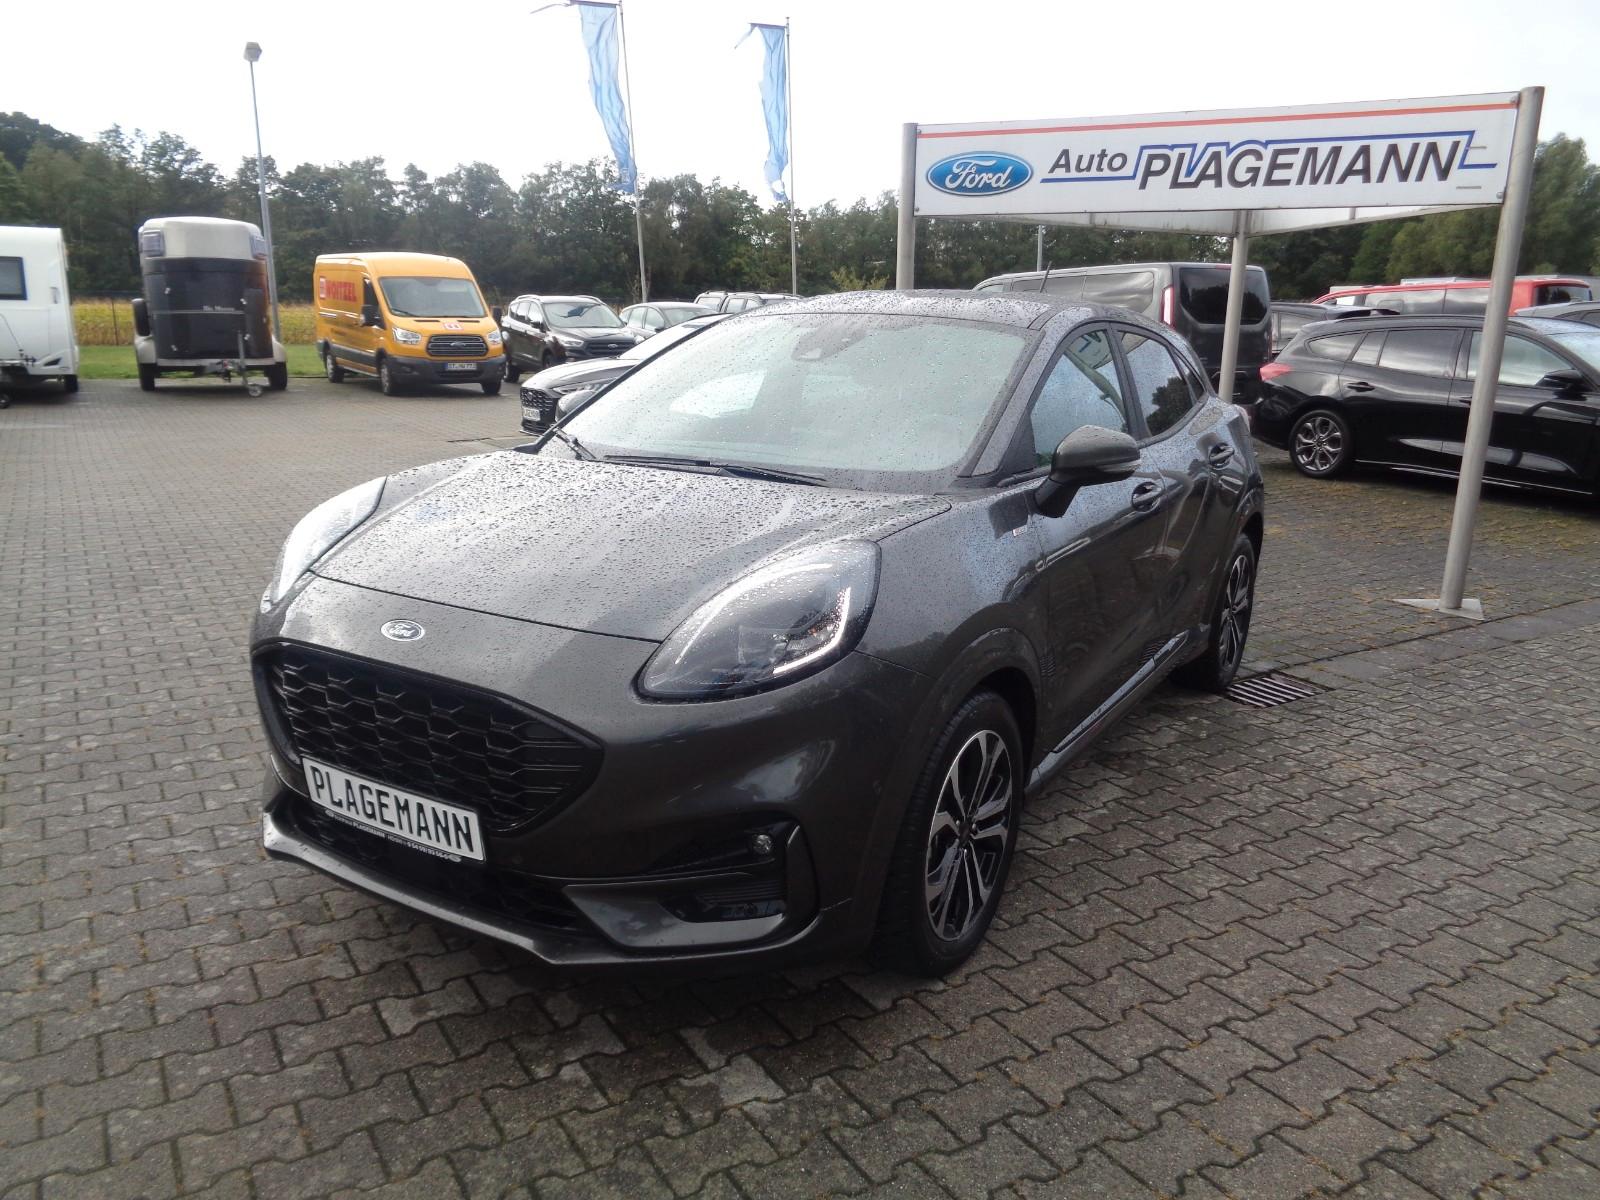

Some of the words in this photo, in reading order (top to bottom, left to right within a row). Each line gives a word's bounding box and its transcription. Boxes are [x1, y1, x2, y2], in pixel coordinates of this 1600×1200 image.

[945, 158, 1012, 189] Ford
[1048, 148, 1128, 175] Auto
[1138, 139, 1461, 190] PLAGEMANN
[309, 765, 474, 853] PLAGEMANN
